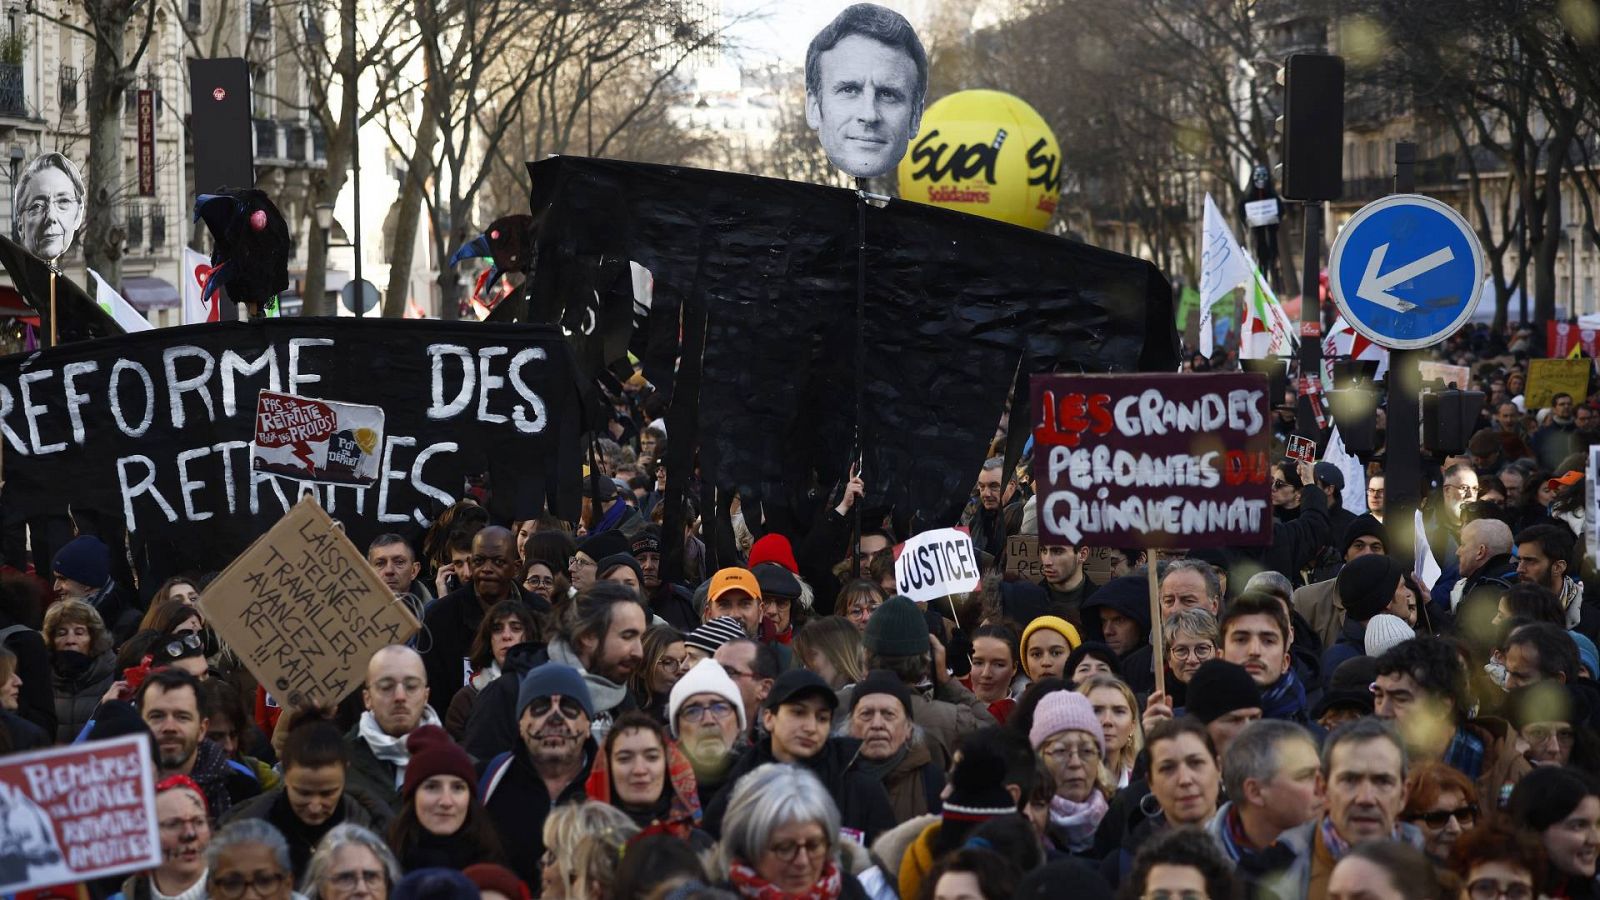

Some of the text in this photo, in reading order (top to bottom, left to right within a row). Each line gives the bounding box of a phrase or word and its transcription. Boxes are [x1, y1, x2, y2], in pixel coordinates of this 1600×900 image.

[928, 186, 991, 204] Solidaires
[261, 398, 297, 412] PAS DE
[426, 343, 547, 433] DES
[278, 432, 291, 444] LES
[288, 411, 337, 442] PROLOS!
[1033, 389, 1114, 447] LES
[1114, 388, 1264, 436] GRANDES
[1049, 444, 1220, 490] PERDANTES
[1224, 449, 1267, 487] DU
[900, 539, 978, 593] JUSTICE!
[1010, 541, 1027, 557] LA
[298, 550, 378, 647] JEUNESSE
[243, 572, 349, 698] AVANCEZ LA
[370, 607, 400, 643] LA
